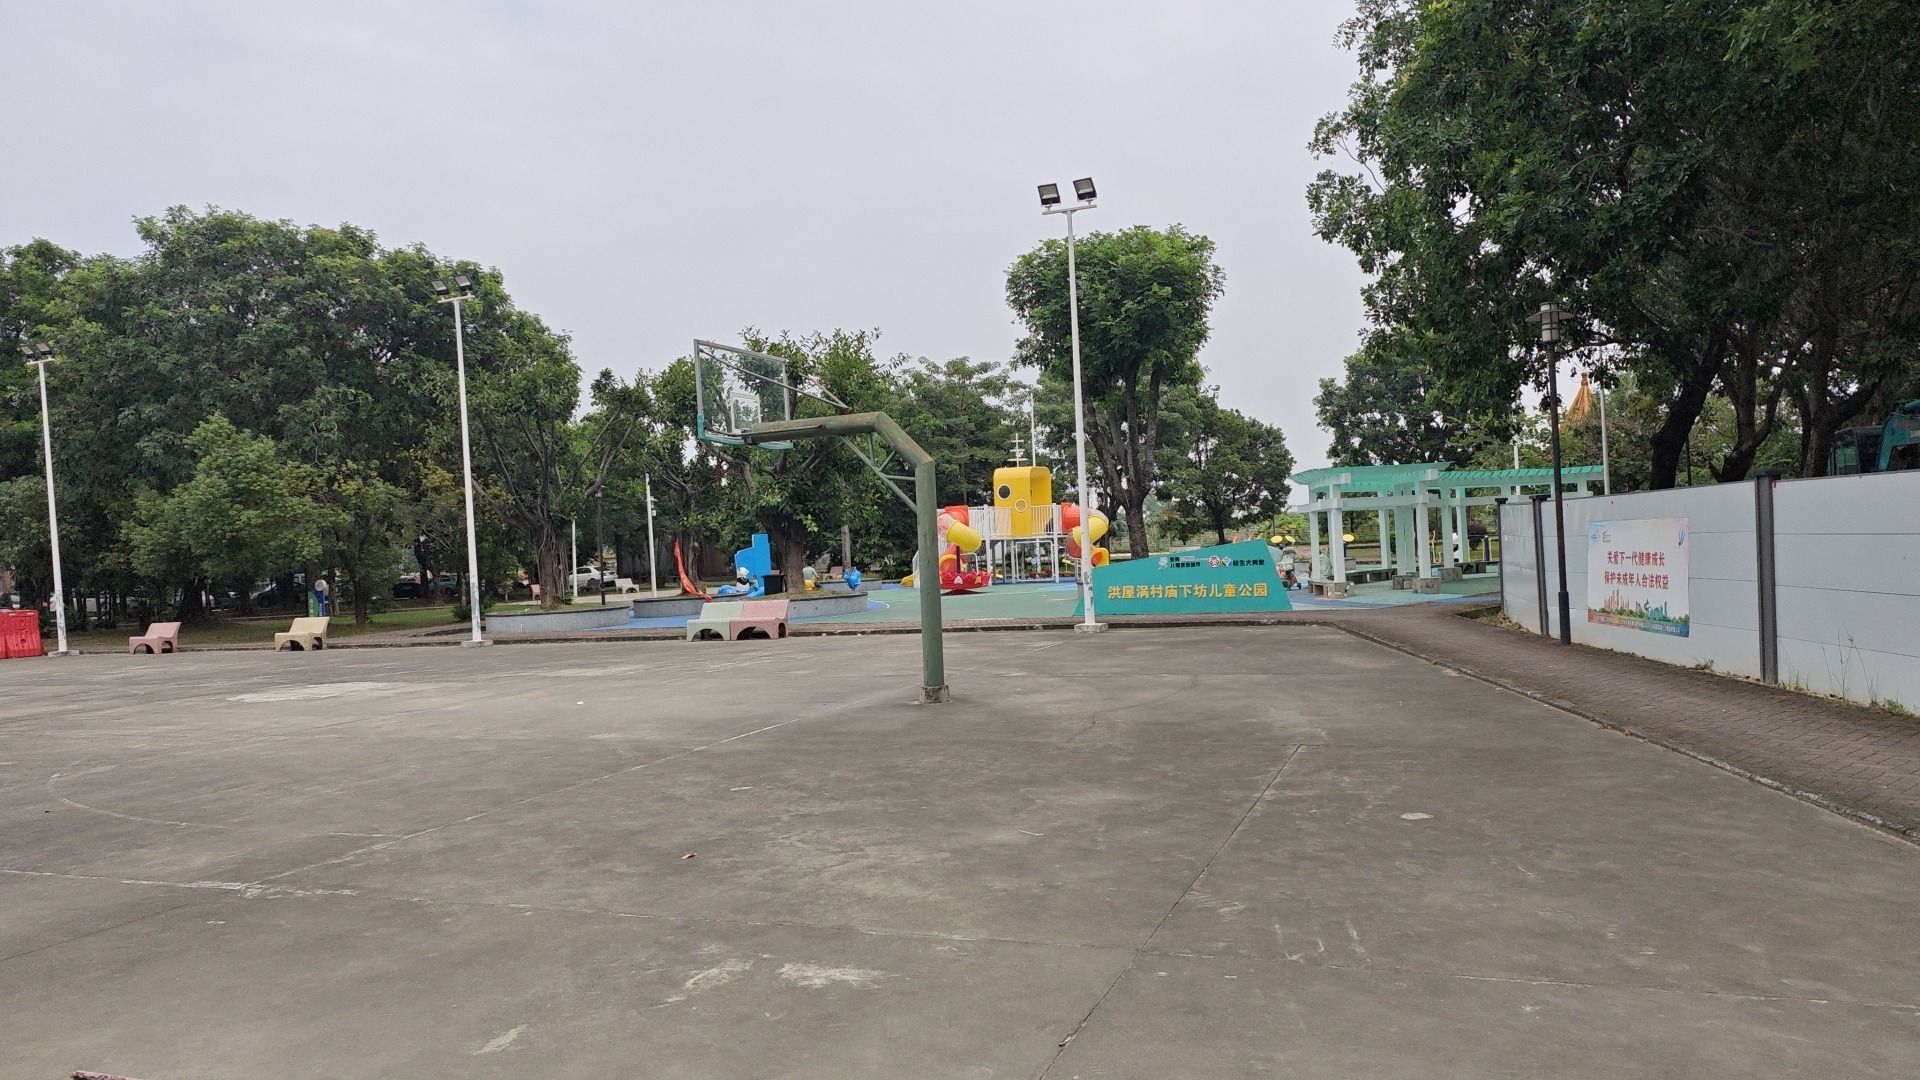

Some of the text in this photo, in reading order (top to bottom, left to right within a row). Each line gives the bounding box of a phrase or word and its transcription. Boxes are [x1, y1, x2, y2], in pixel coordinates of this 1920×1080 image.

[1607, 551, 1665, 566] 关爱下一代健康成长
[1604, 571, 1669, 589] 保护未成年人合法权益
[1108, 583, 1268, 599] 洪屋涡村庙下坊儿童公园
